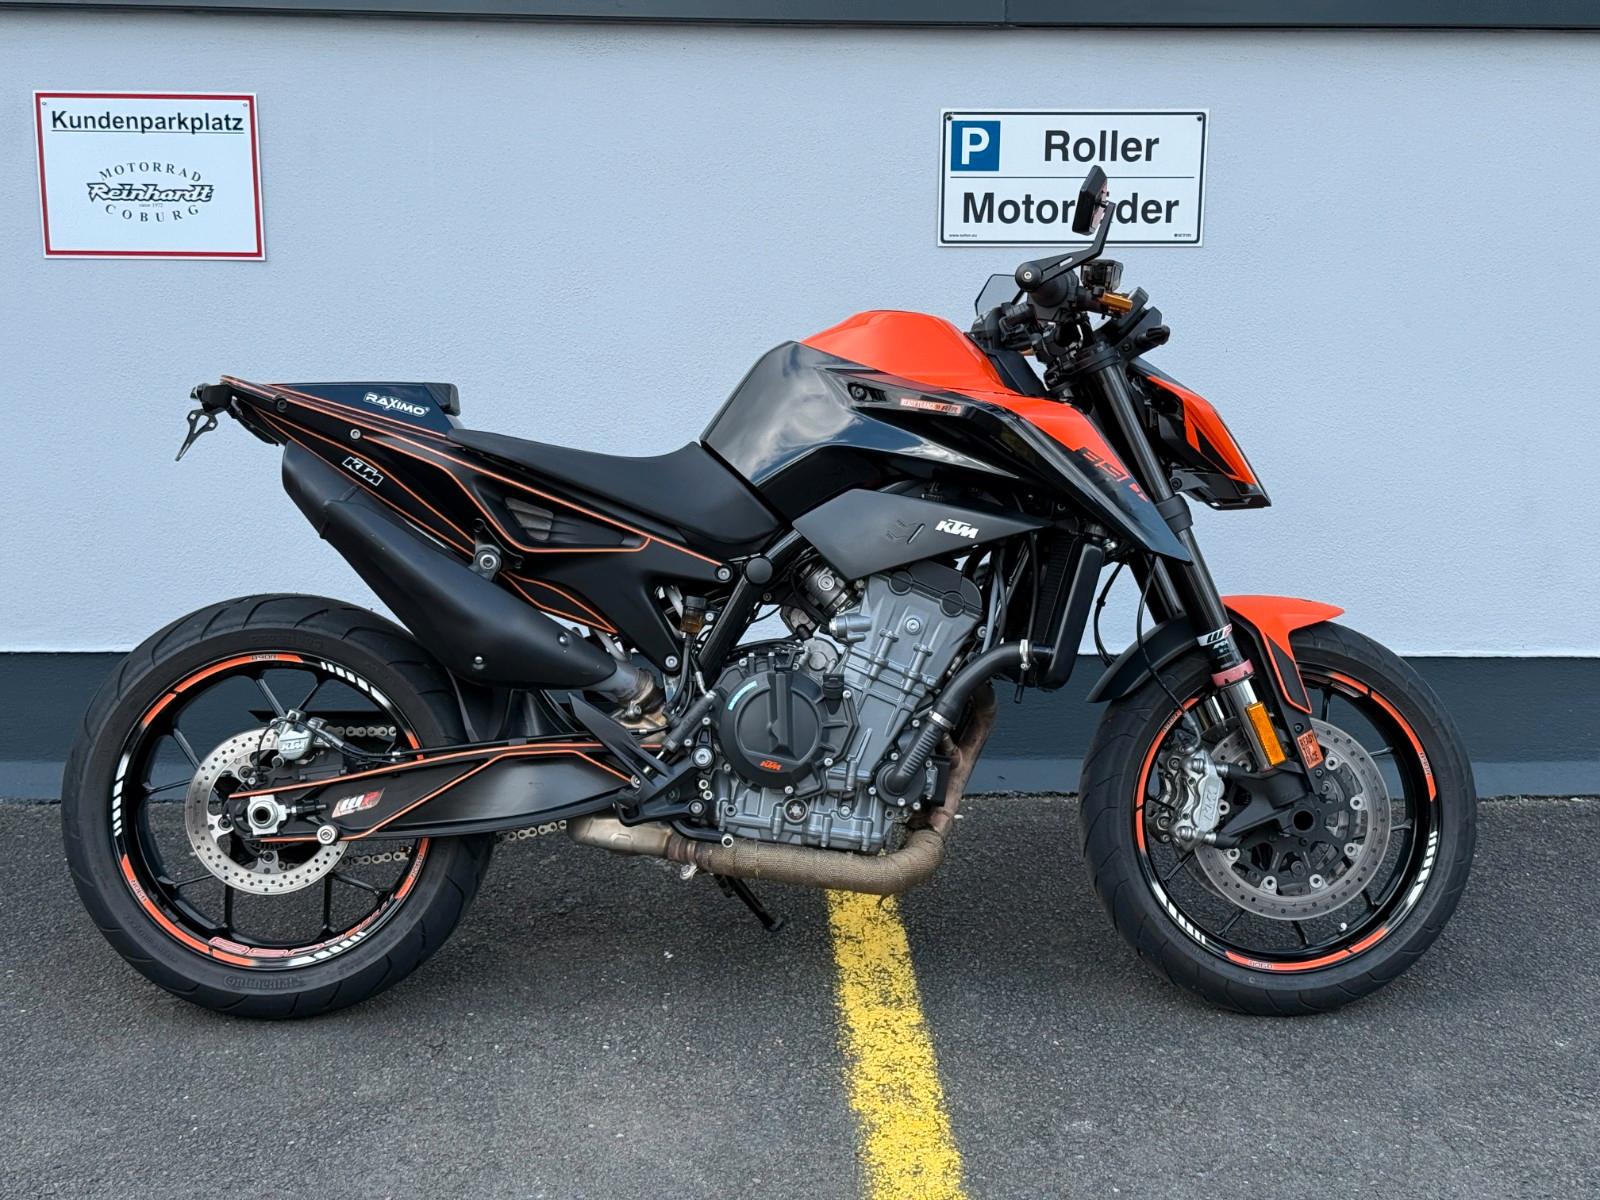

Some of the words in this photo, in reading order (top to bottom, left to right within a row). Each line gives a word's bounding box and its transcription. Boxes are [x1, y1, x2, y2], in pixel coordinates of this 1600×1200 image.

[52, 110, 244, 134] Kundenparkplatz
[961, 127, 990, 165] P
[1044, 129, 1160, 162] Roller
[98, 161, 201, 181] MOTORRAD
[87, 182, 214, 202] Reinhardt
[105, 204, 199, 222] COBURG
[962, 192, 1180, 225] Motorder
[364, 392, 428, 417] RAXIMO
[342, 457, 383, 486] KTM
[935, 518, 979, 539] KTM
[760, 760, 782, 771] KTM
